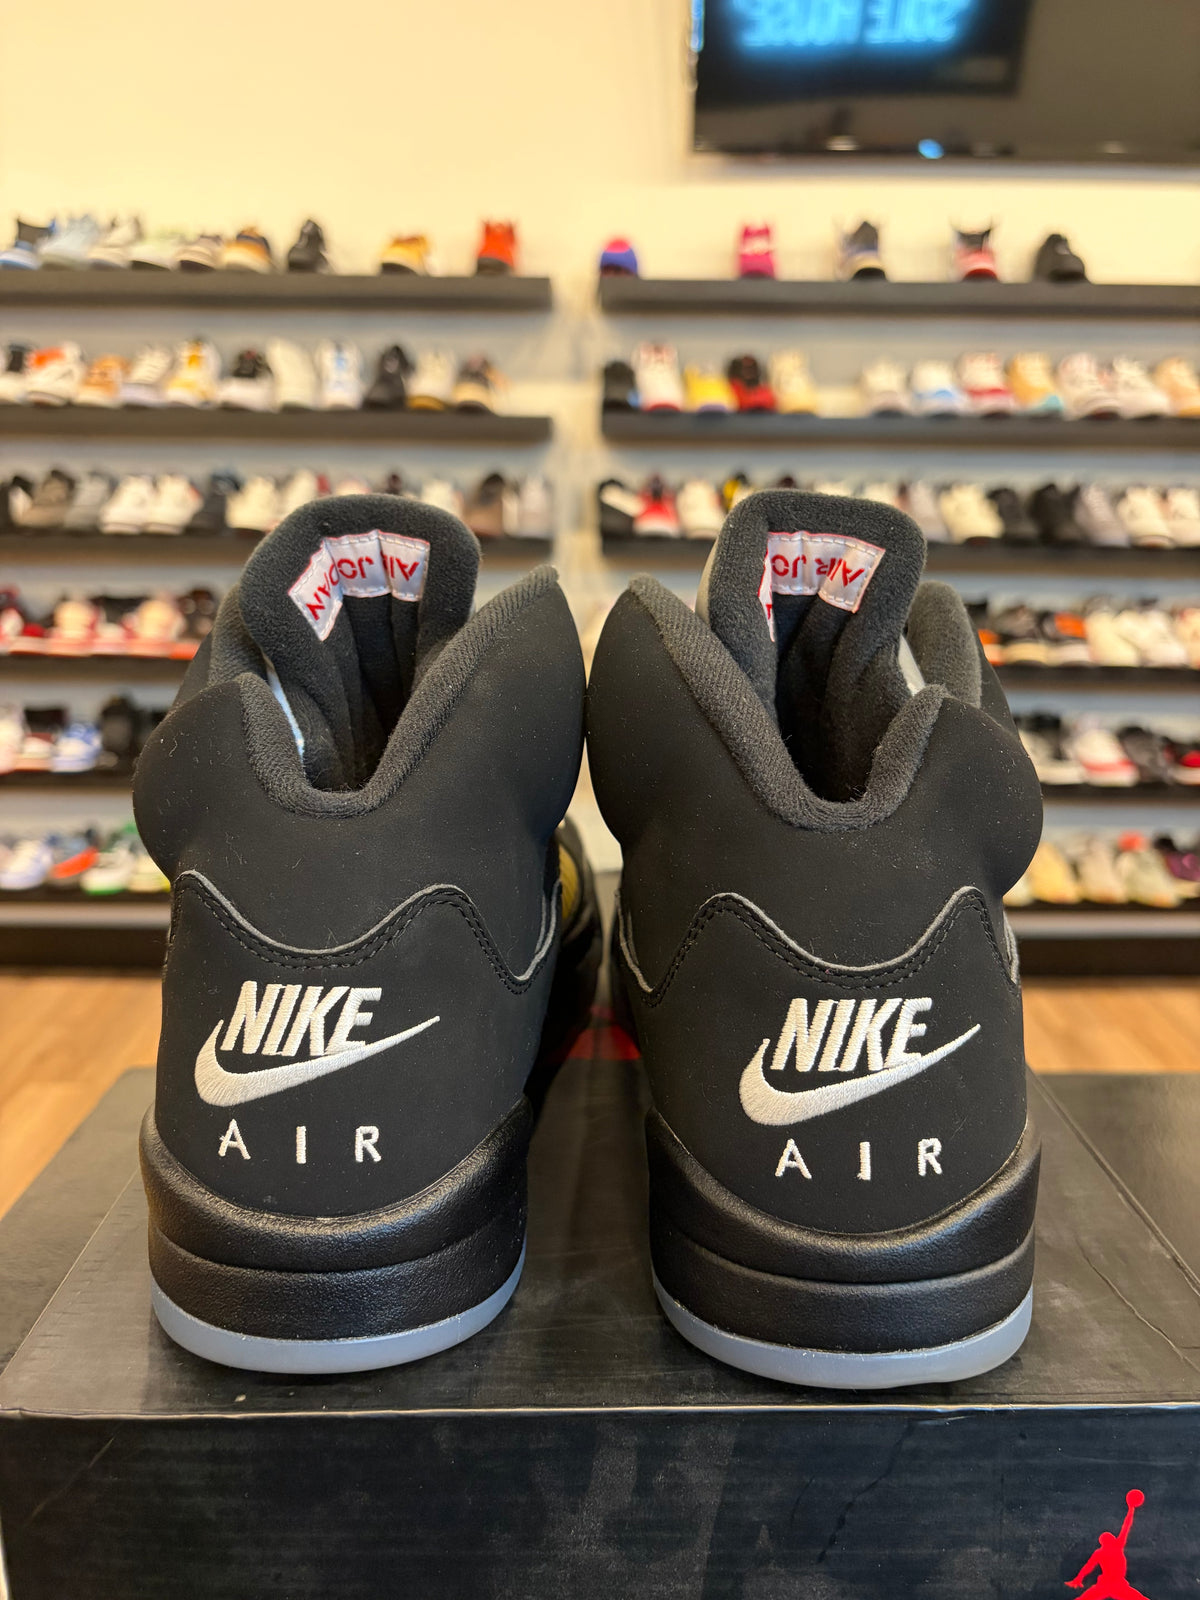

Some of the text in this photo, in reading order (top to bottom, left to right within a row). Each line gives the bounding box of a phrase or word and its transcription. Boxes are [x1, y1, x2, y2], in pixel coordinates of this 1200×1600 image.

[814, 557, 865, 588] AIR
[220, 980, 382, 1056] NIKE
[770, 997, 932, 1072] NIKE
[218, 1119, 381, 1164] AIR
[775, 1138, 942, 1180] AIR
